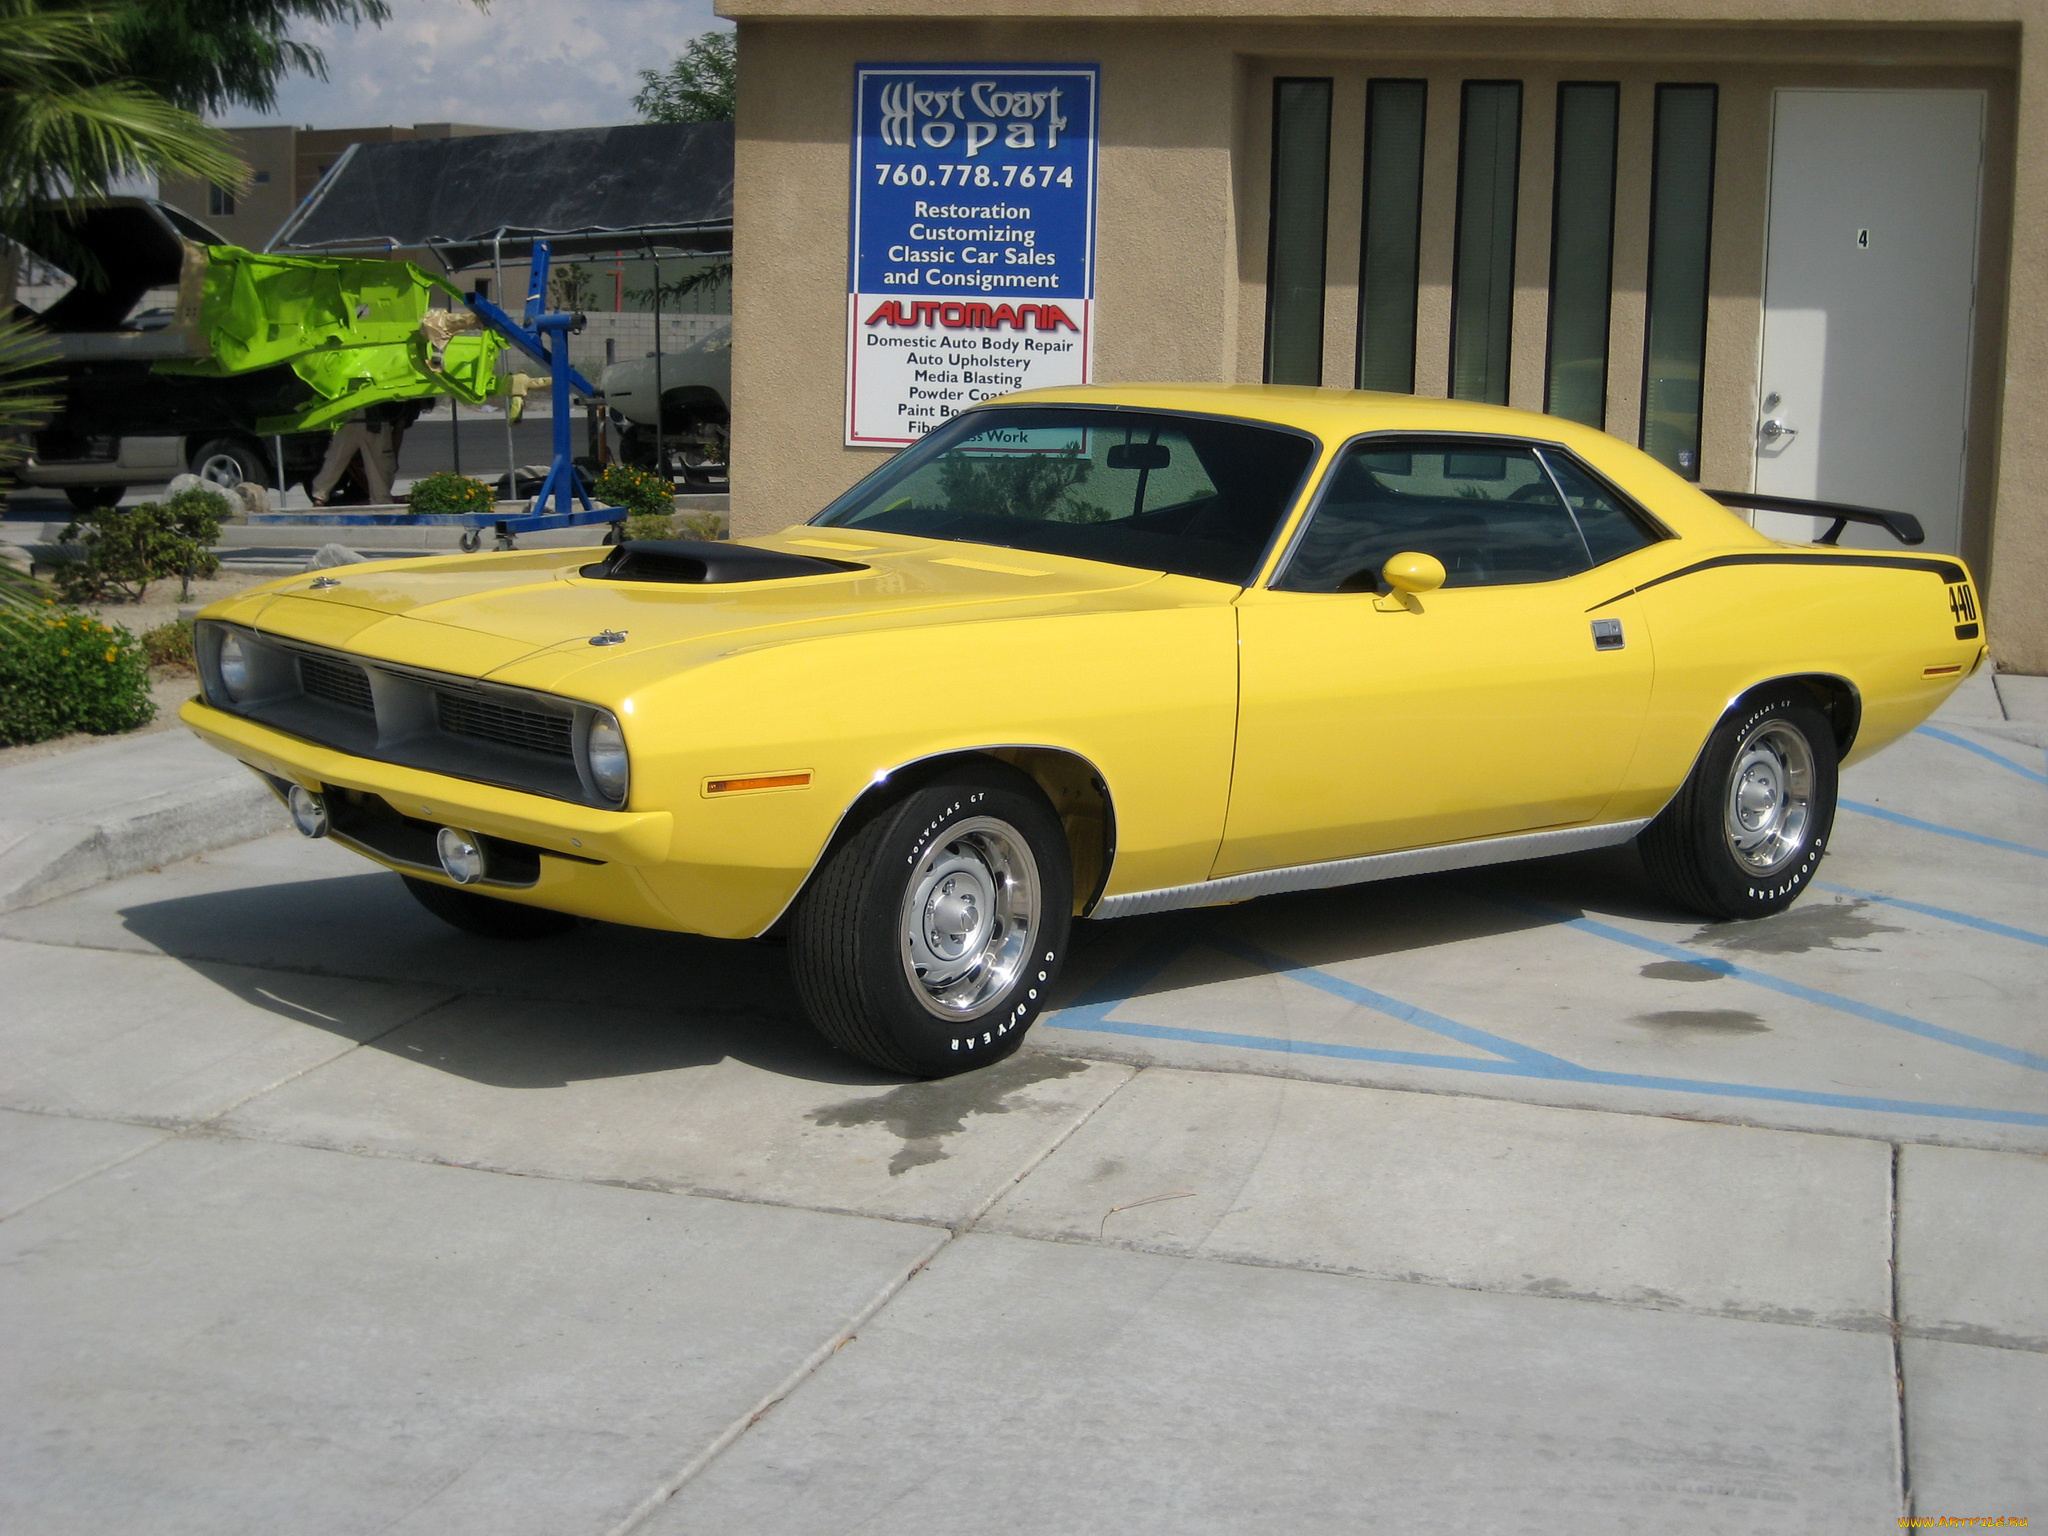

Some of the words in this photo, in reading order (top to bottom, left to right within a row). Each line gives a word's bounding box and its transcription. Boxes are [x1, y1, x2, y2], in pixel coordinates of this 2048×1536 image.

[880, 81, 965, 119] West
[971, 81, 1063, 121] Coast
[880, 114, 1068, 158] Mopar
[875, 164, 1073, 188] 760.778.7674
[914, 201, 1031, 220] Restoration
[909, 223, 1036, 247] Customizing
[1858, 229, 1868, 247] 4
[888, 245, 955, 263] Classic
[961, 247, 999, 264] Car
[1004, 248, 1056, 266] Sales
[883, 268, 919, 285] and
[925, 269, 1059, 291] Consignment
[864, 300, 1080, 332] AUTOMANIA
[866, 333, 937, 349] Domestic
[940, 336, 977, 350] Auto
[982, 337, 1020, 354] Body
[1024, 338, 1074, 355] Repair
[906, 352, 943, 366] Auto
[949, 353, 1031, 371] Upholstery
[914, 370, 958, 384] Media
[963, 371, 1022, 388] Blasting
[909, 386, 964, 400] Powder
[898, 403, 935, 417] Paint
[987, 430, 1028, 443] Work
[1949, 584, 1977, 623] 440
[1736, 703, 1775, 742] POLYGLAS
[907, 801, 961, 865] POLYGLAS
[970, 792, 985, 803] GT
[1748, 838, 1822, 900] GOODYEAR
[950, 951, 1055, 1051] GOODYEAR
